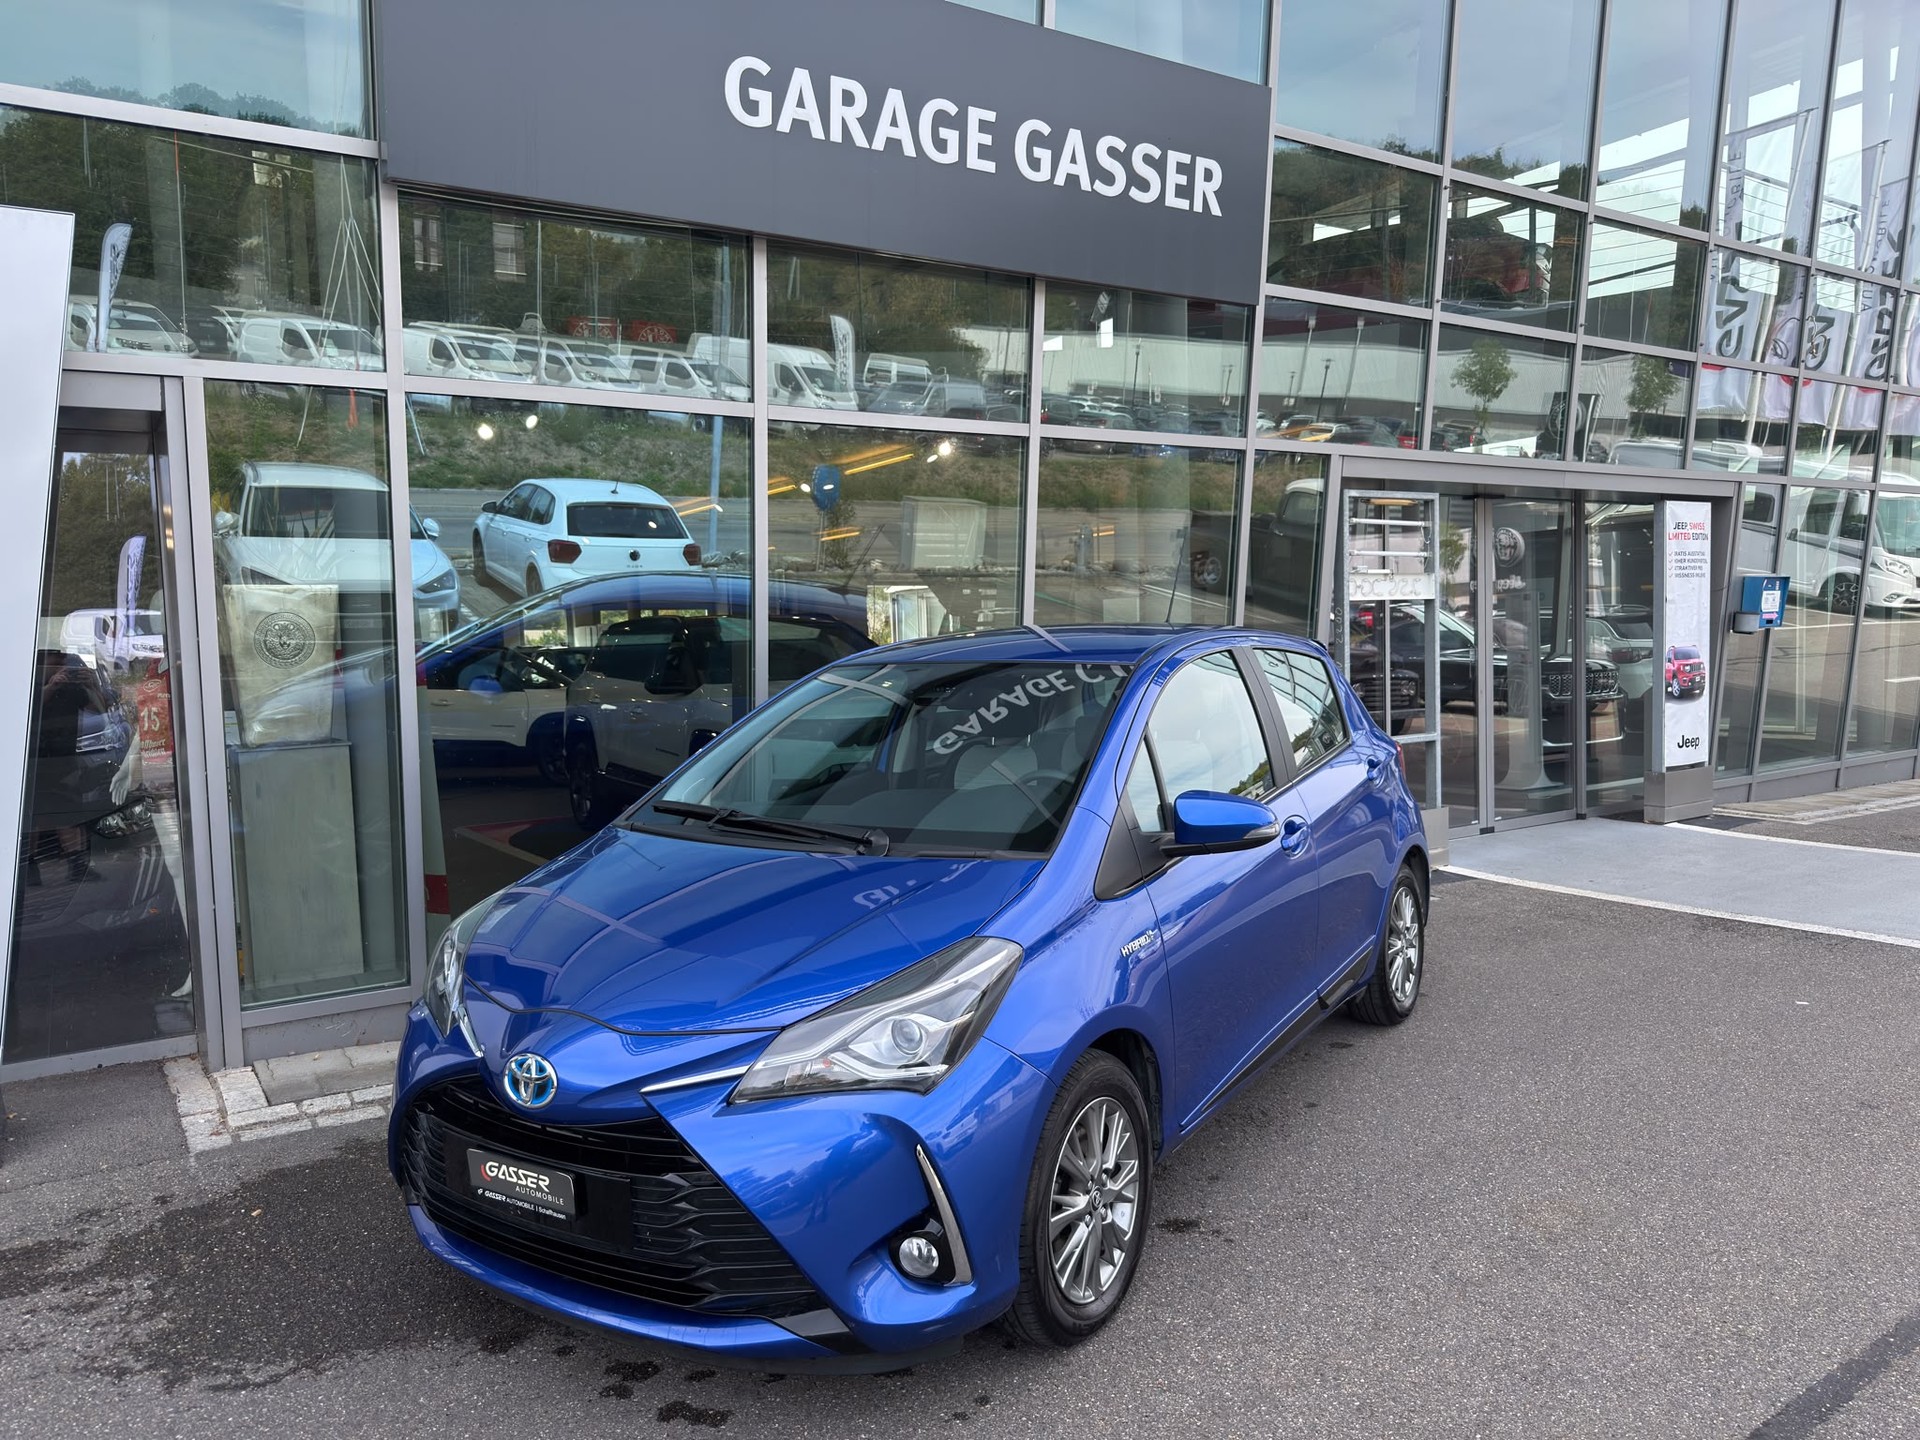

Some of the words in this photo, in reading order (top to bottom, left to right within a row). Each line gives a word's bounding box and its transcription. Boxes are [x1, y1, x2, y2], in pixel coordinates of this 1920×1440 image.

[724, 55, 998, 174] GARAGE
[1014, 119, 1223, 217] GASSER
[1689, 522, 1705, 530] SWISS
[140, 706, 160, 732] 15
[1677, 735, 1699, 750] Jeep
[1120, 933, 1152, 957] HYBRID
[485, 1161, 550, 1192] GASSER
[484, 1190, 506, 1202] GASSER
[506, 1197, 535, 1211] AUTOMOBILE
[515, 1185, 564, 1206] AUTOMOBILE
